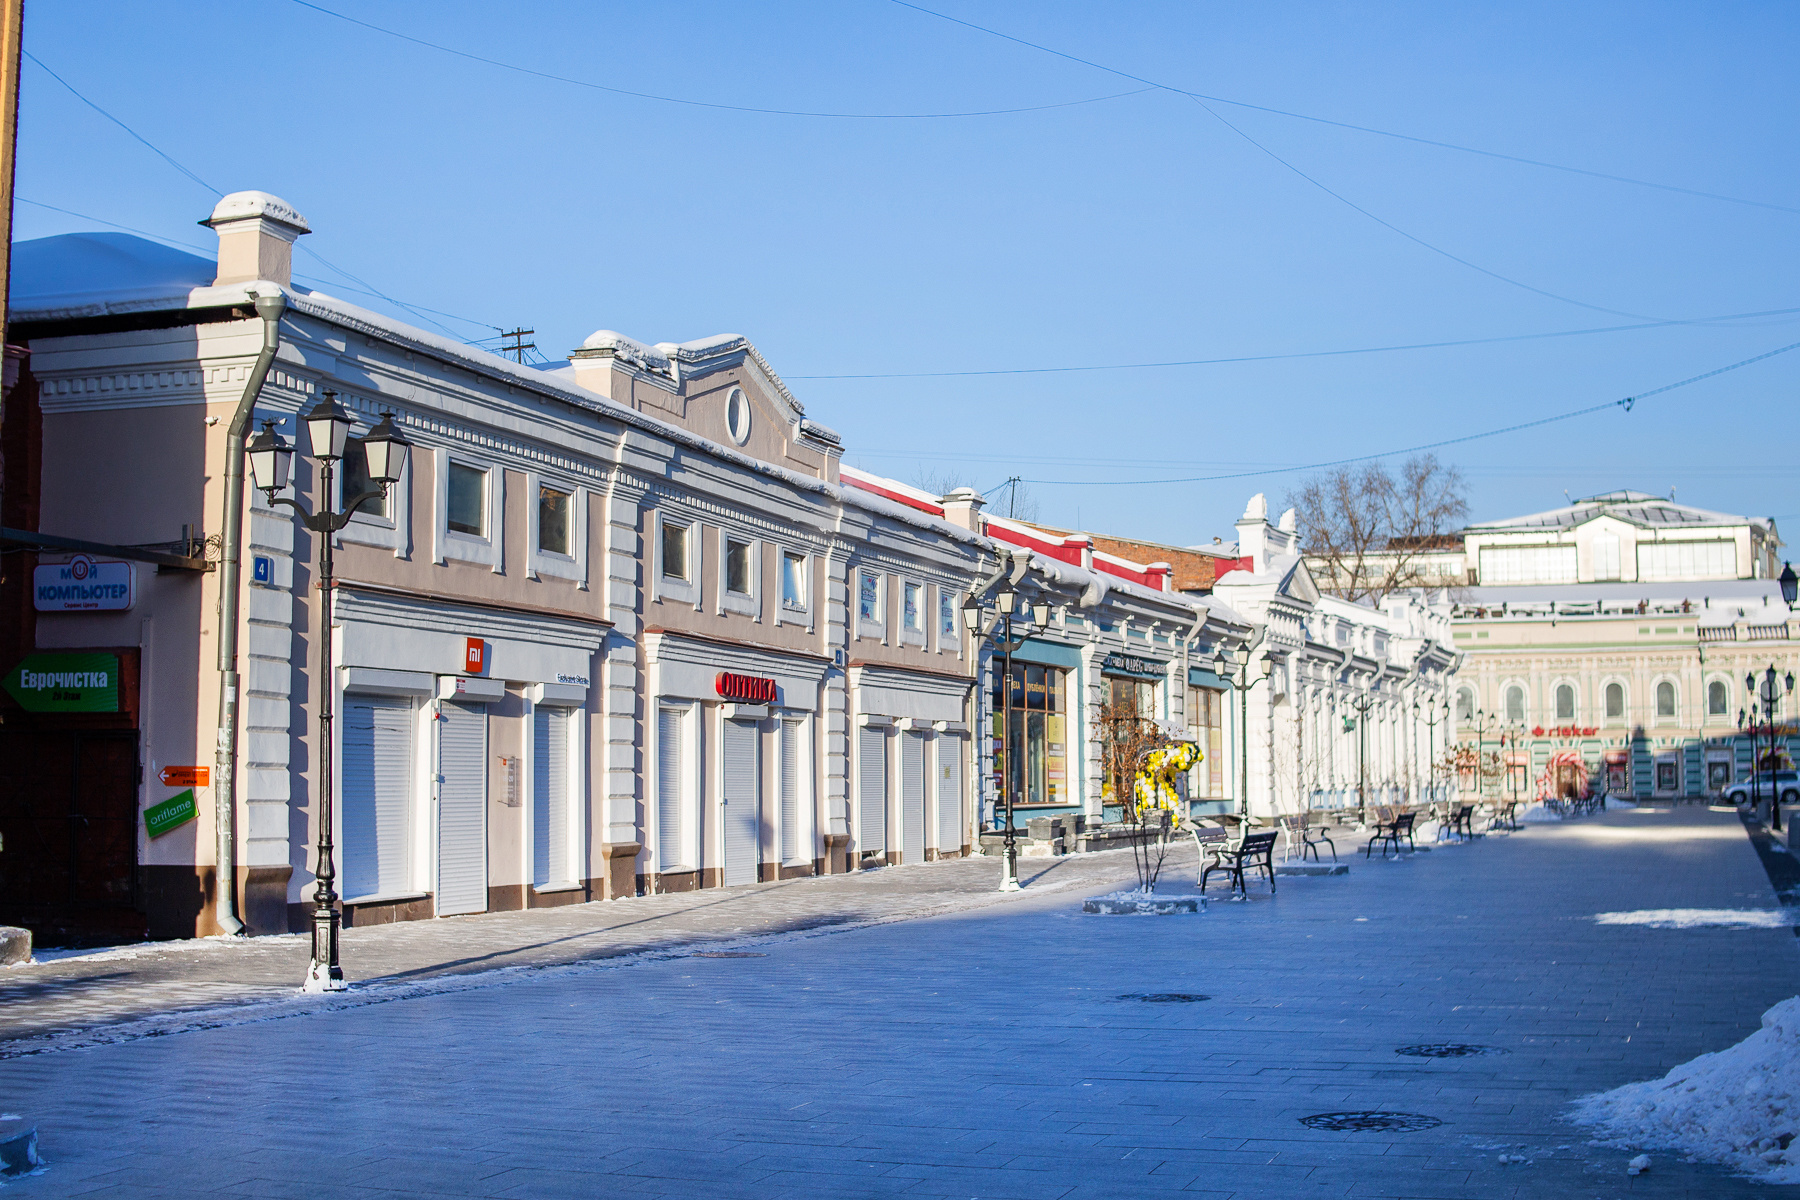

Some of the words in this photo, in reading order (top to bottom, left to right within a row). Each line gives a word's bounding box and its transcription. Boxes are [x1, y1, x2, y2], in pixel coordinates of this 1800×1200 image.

[258, 563, 265, 576] 4
[38, 584, 128, 600] КОМПЬЮТЕР
[20, 669, 108, 691] Еврочистка
[716, 671, 778, 702] ОПТИКА
[1548, 723, 1600, 737] rieker
[150, 800, 191, 825] oriflame
